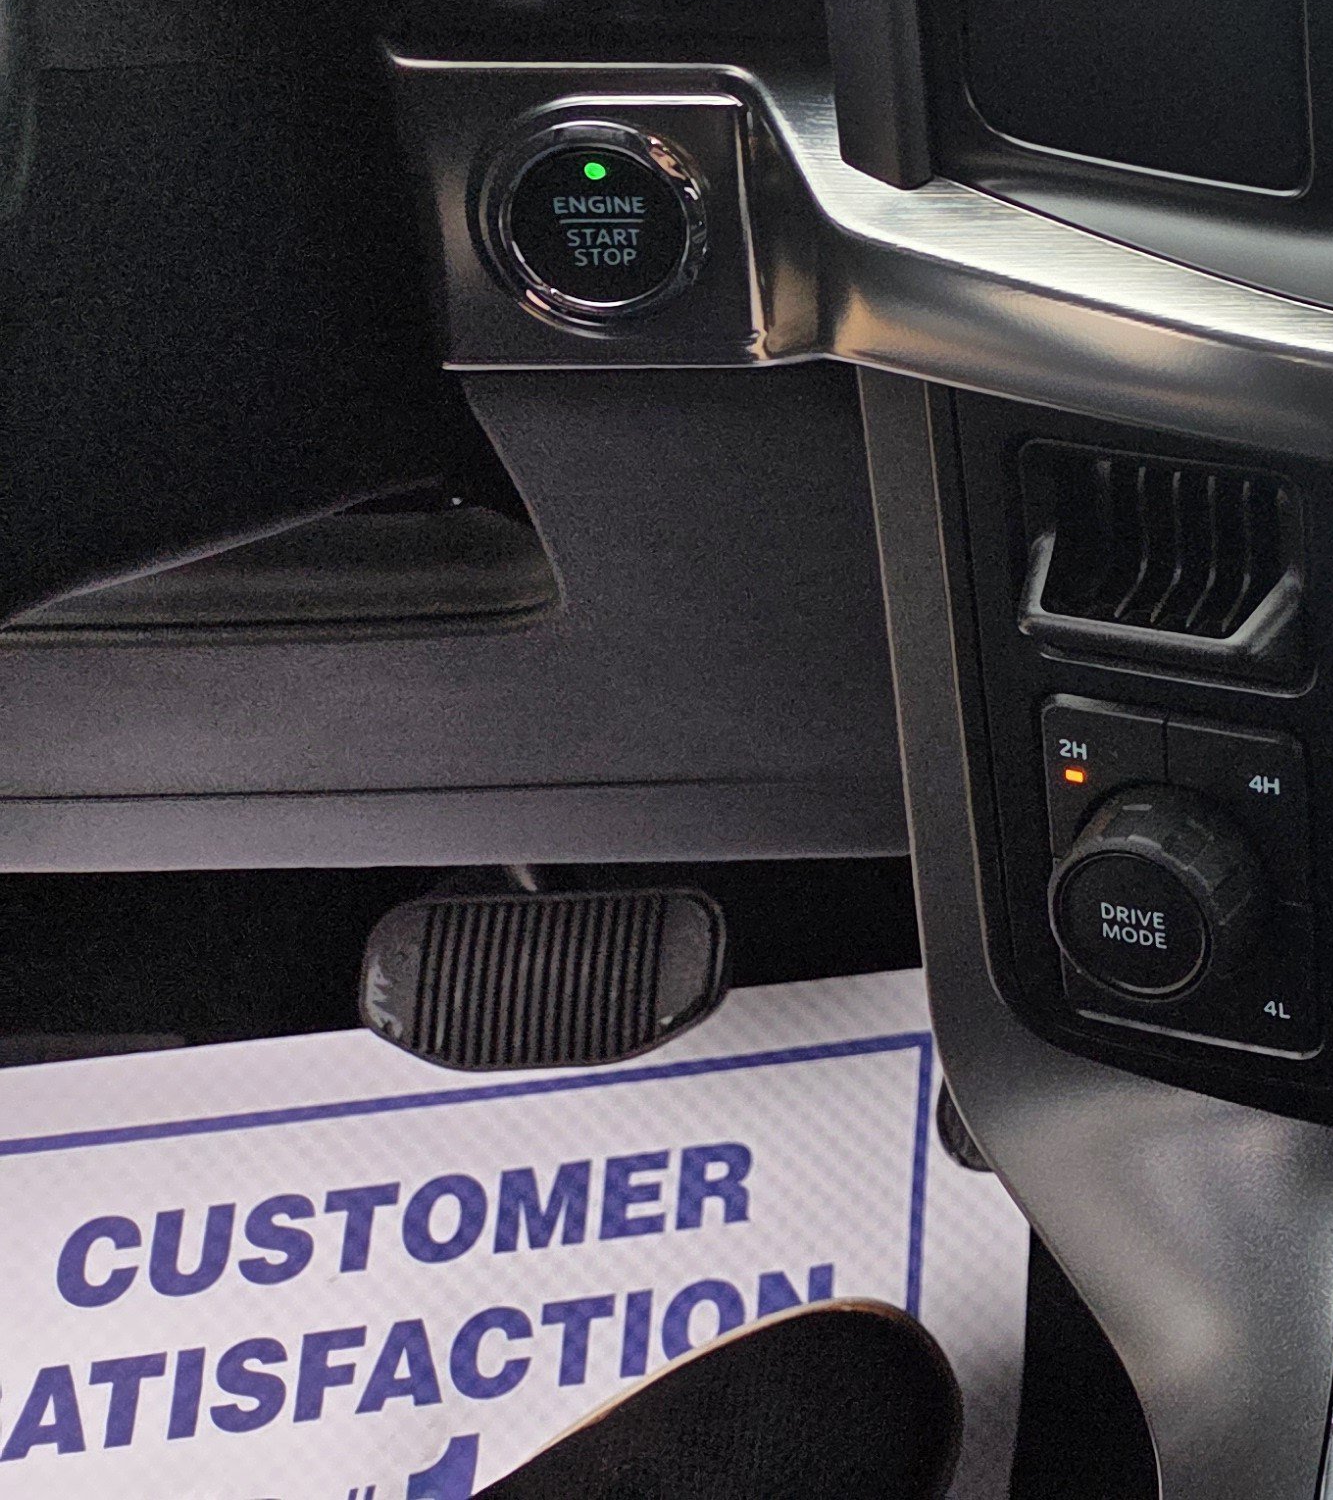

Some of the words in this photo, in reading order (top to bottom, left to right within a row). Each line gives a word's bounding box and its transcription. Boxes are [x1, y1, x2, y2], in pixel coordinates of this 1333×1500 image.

[553, 196, 646, 215] ENGINE
[566, 228, 640, 247] START
[574, 248, 637, 267] STOP
[1059, 738, 1088, 761] 2H
[1248, 775, 1281, 796] 4H
[1100, 902, 1165, 930] DRIVE
[1101, 921, 1167, 950] MODE
[1263, 1000, 1291, 1020] 4L
[56, 1141, 753, 1307] CUSTOMER
[0, 1263, 835, 1463] ATISFACTIO
